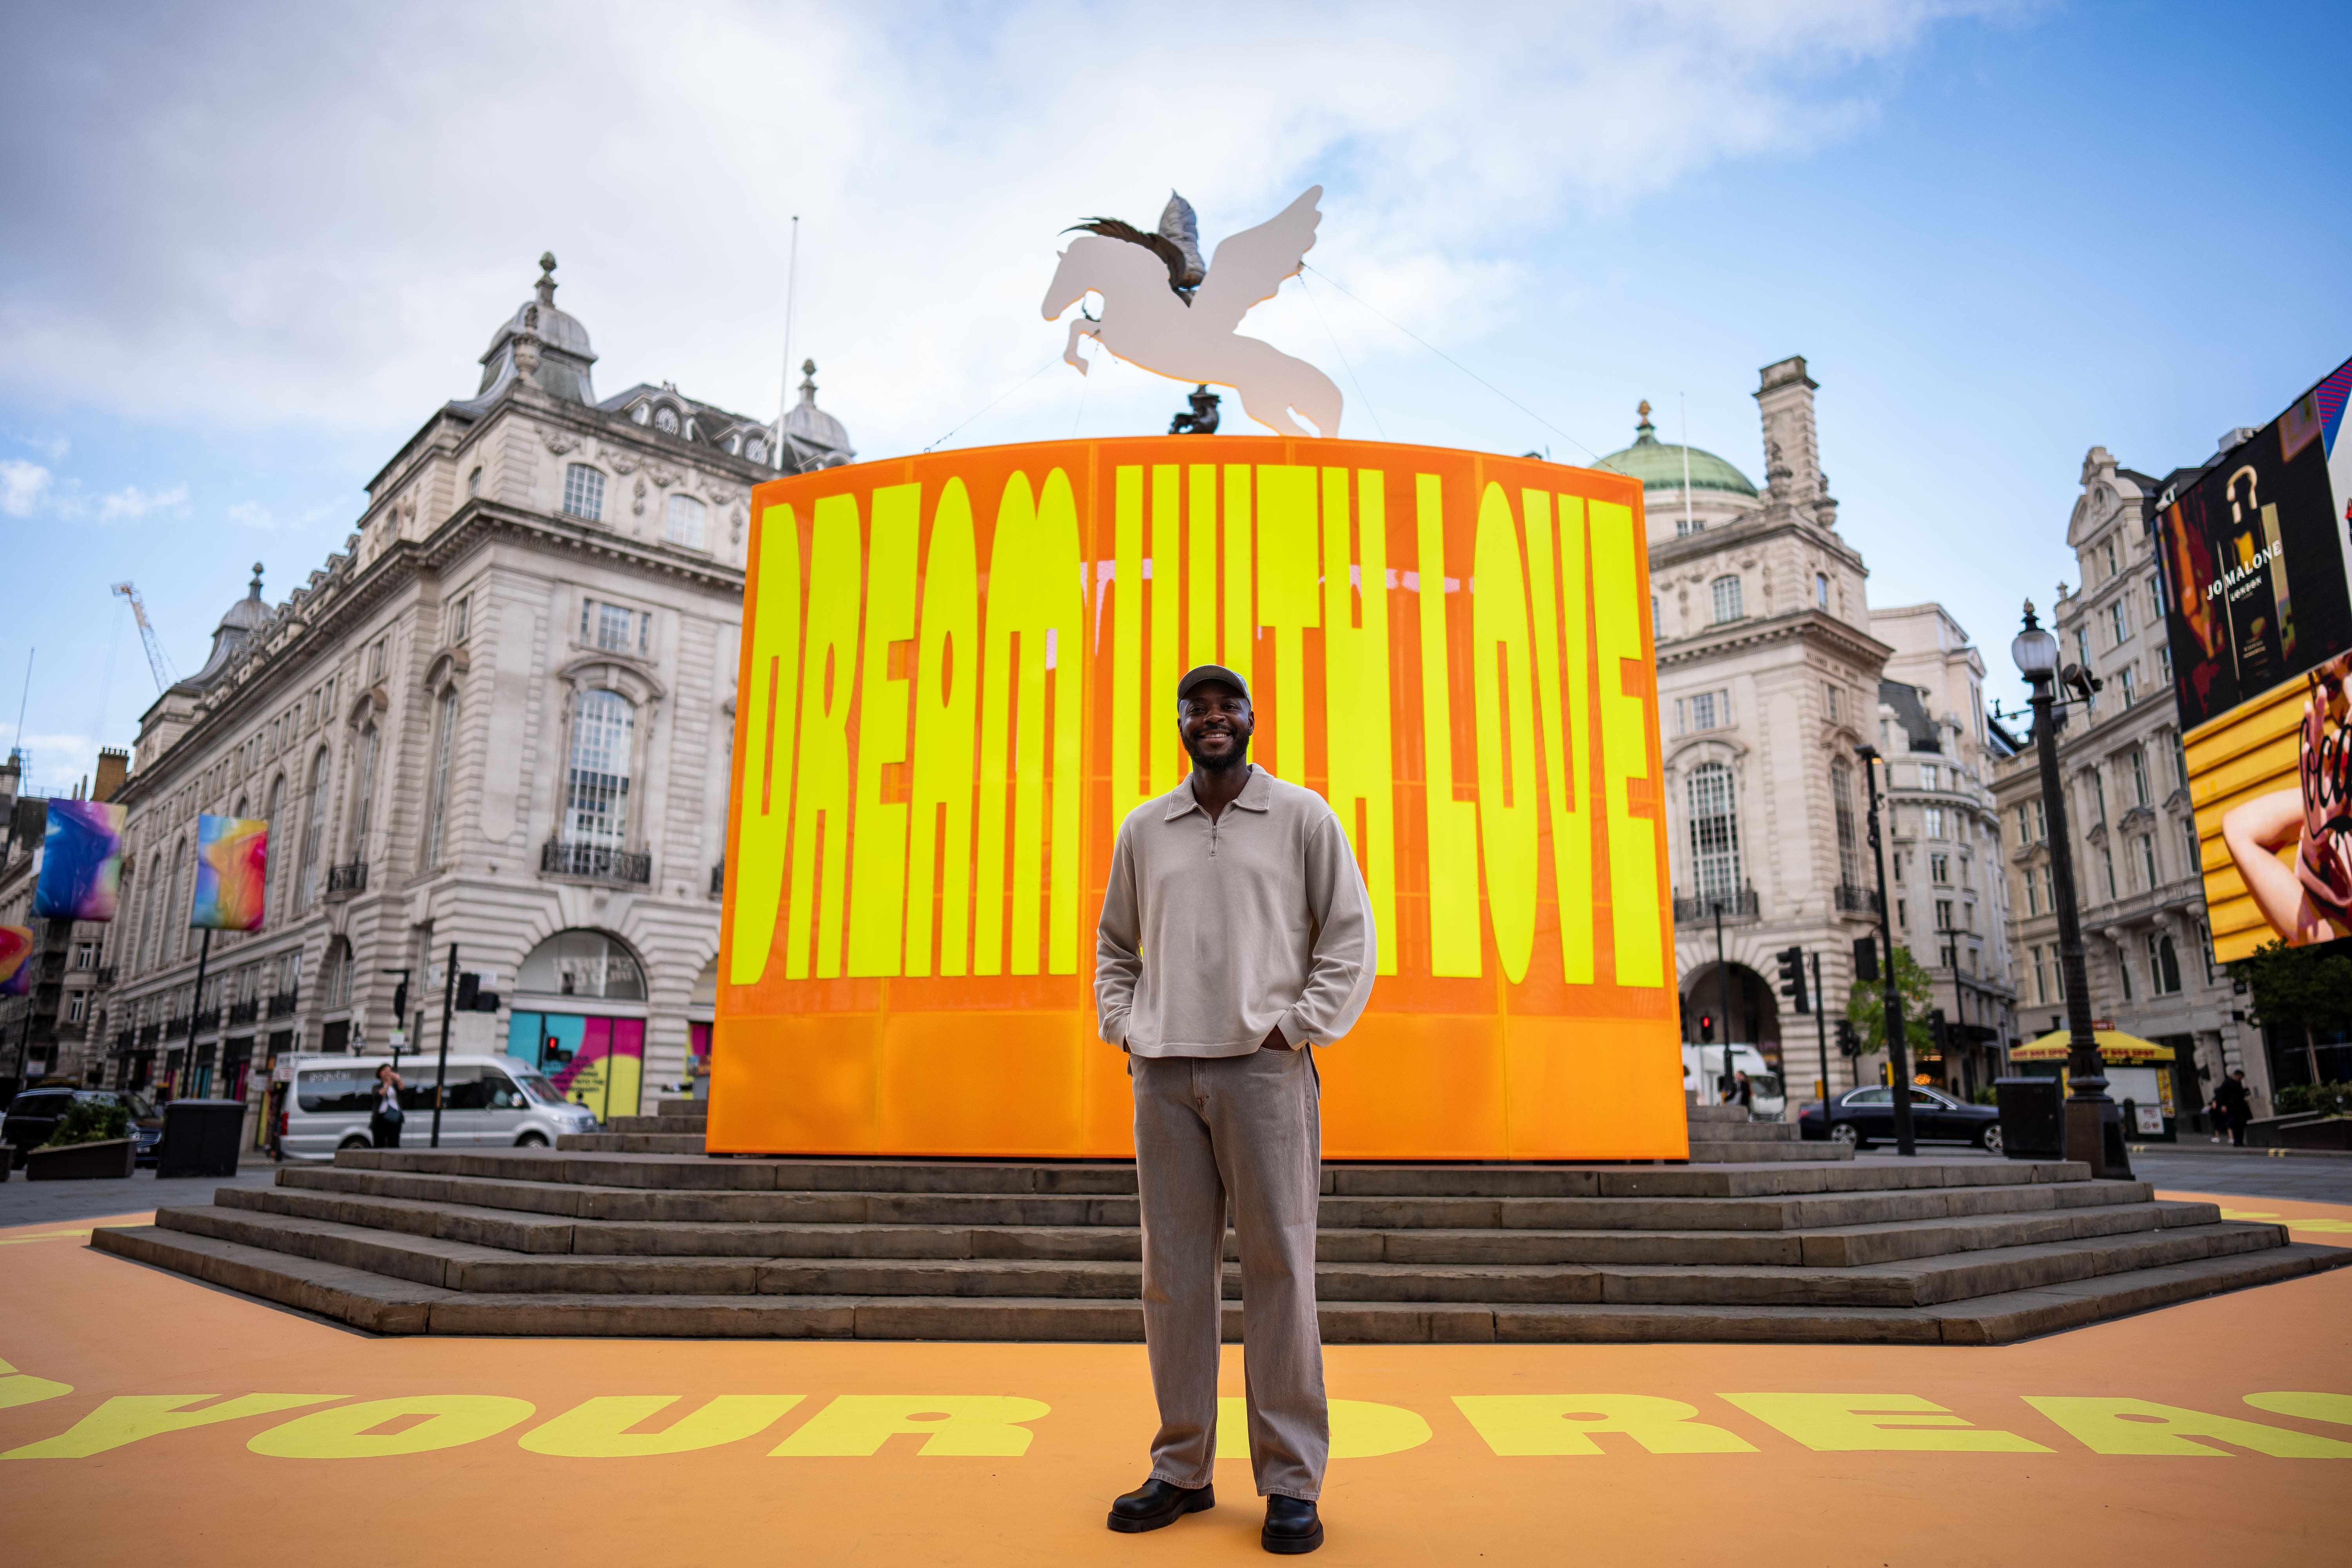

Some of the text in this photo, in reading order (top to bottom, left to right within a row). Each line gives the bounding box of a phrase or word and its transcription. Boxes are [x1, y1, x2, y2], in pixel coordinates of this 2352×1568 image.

[2207, 540, 2282, 600] JO MALONE
[2230, 576, 2262, 602] LONDON
[731, 468, 1082, 985] DREAM
[1416, 474, 1663, 987] LOVE
[0, 1394, 1051, 1459] YOUR
